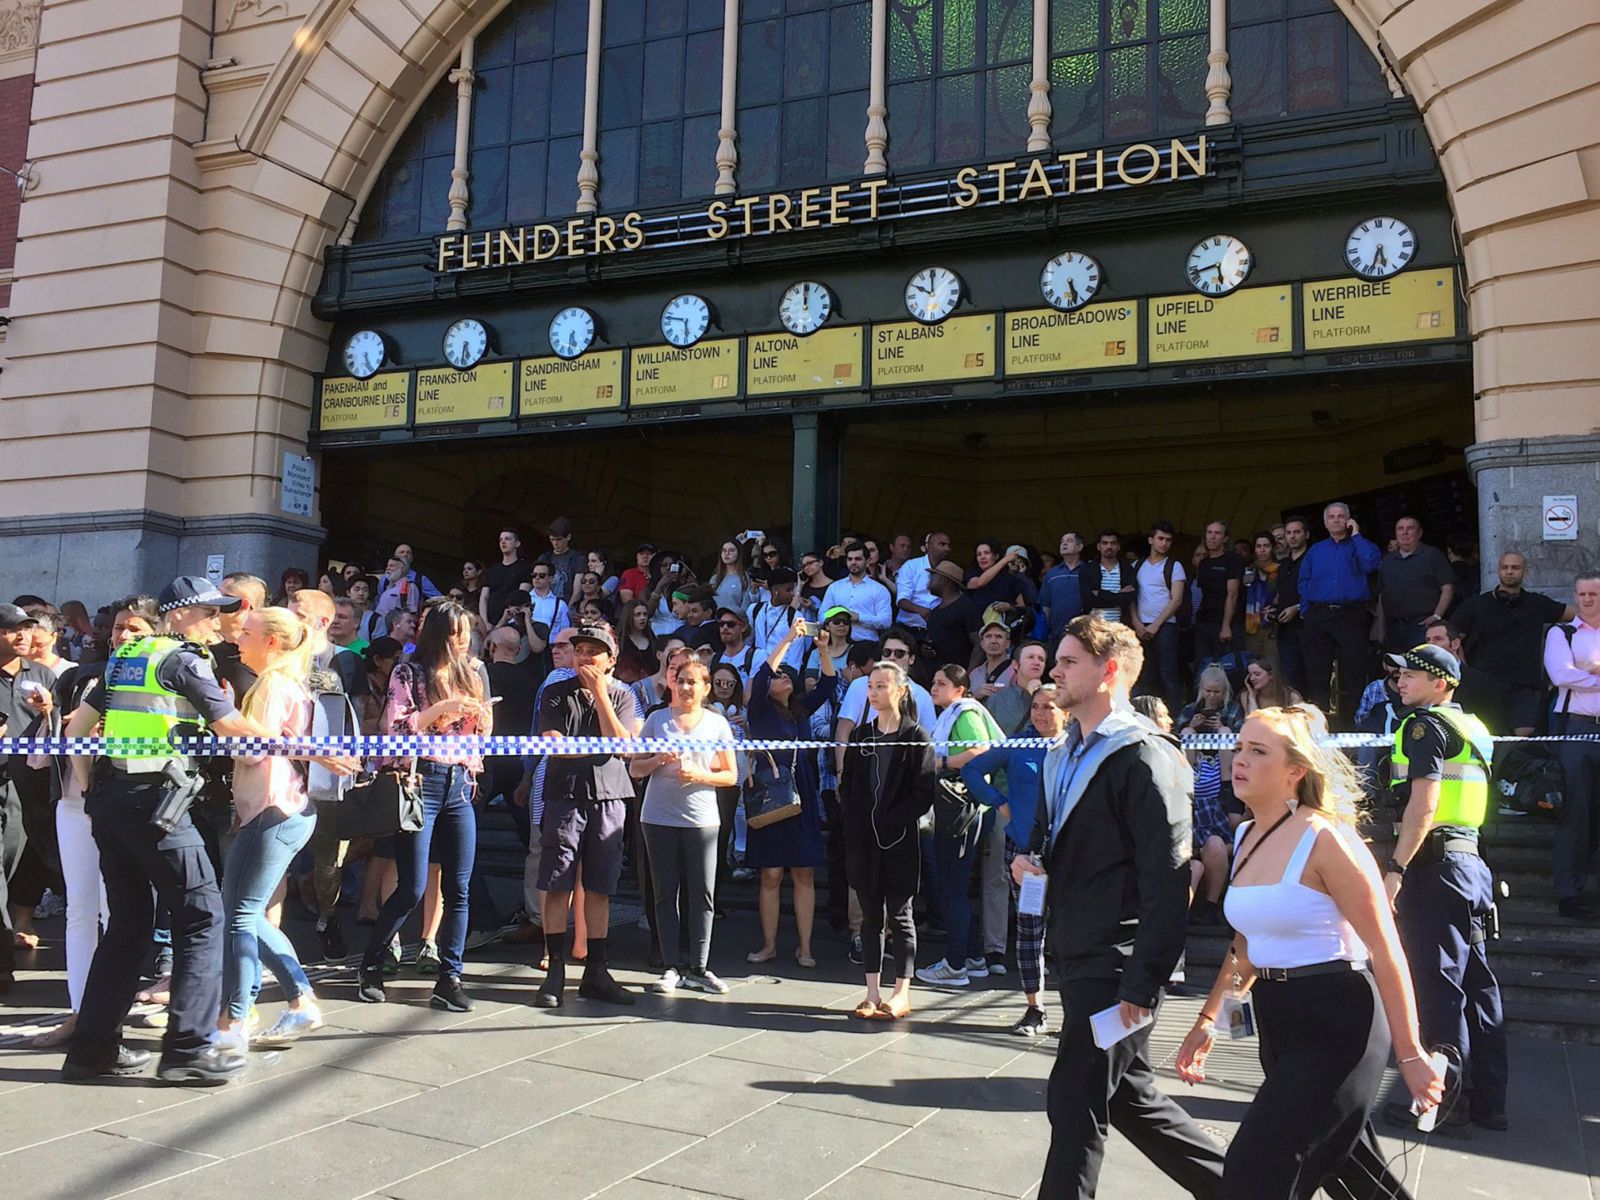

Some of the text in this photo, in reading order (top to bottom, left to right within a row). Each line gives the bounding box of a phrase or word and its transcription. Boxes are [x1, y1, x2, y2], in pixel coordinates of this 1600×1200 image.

[438, 135, 1207, 272] FLINDERS STREET STATION
[1312, 282, 1391, 302] WERRIBEE
[1156, 299, 1214, 317] UPFIELD
[1312, 306, 1344, 321] LINE
[1011, 307, 1126, 331] BROADMEADOWS
[878, 326, 944, 343] ST ALBANS
[1156, 320, 1187, 335] LINE
[1313, 325, 1371, 339] PLATFORM
[754, 338, 799, 353] ALTONA
[1012, 334, 1040, 348] LINE
[1156, 339, 1209, 352] PLATFORM
[637, 346, 720, 364] WILLIAMSTOWN
[878, 346, 904, 360] LINE
[1012, 353, 1061, 365] PLATFORM
[525, 358, 600, 376] SANDRINGHAM
[753, 356, 778, 370] LINE
[878, 364, 924, 375] PLATFORM
[419, 371, 477, 386] FRANKSTON
[636, 368, 659, 381] LINE
[753, 374, 796, 384] PLATFORM
[324, 381, 387, 395] PAKENHAM and
[525, 379, 546, 392] LINE
[635, 385, 676, 396] PLATFORM
[323, 392, 406, 409] CRANBOURNE LINES
[419, 389, 440, 401] LINE
[525, 396, 563, 406] PLATFORM
[418, 406, 455, 415] PLATFORM
[322, 413, 358, 423] PLATFORM
[108, 661, 144, 681] Plice
